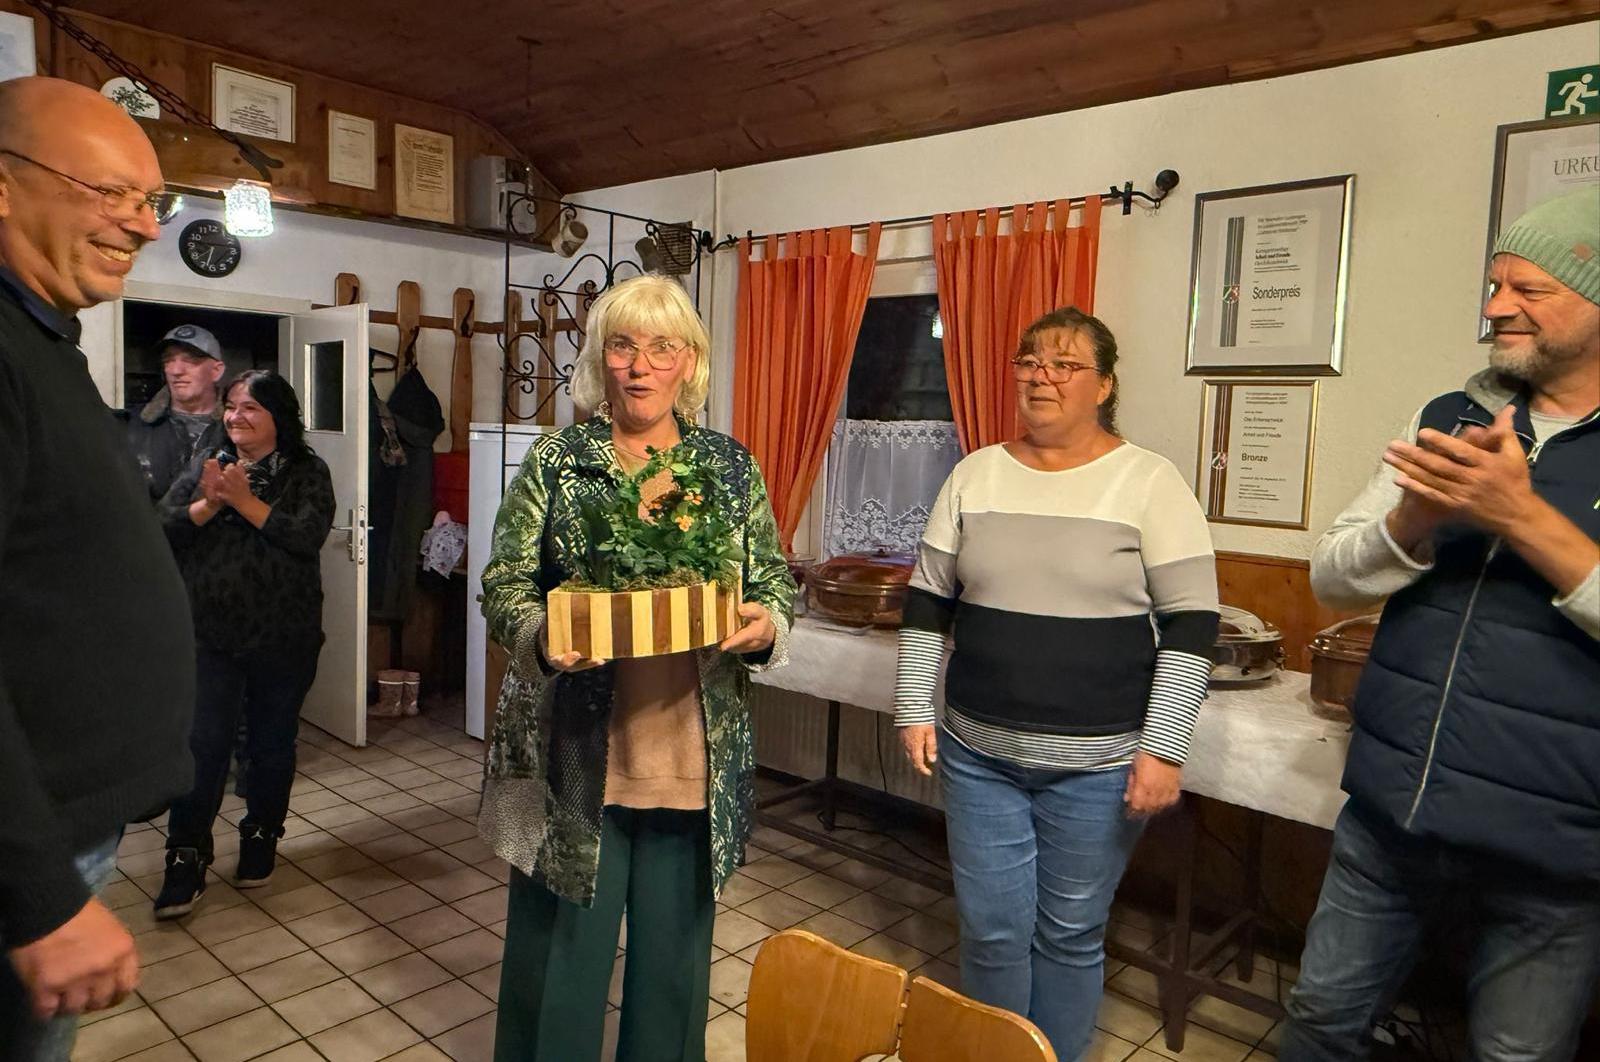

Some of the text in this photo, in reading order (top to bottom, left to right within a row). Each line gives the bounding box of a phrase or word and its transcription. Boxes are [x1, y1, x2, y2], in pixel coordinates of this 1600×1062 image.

[208, 225, 218, 233] 12
[1252, 285, 1301, 300] Sonderpreis
[1241, 453, 1268, 462] Bronze
